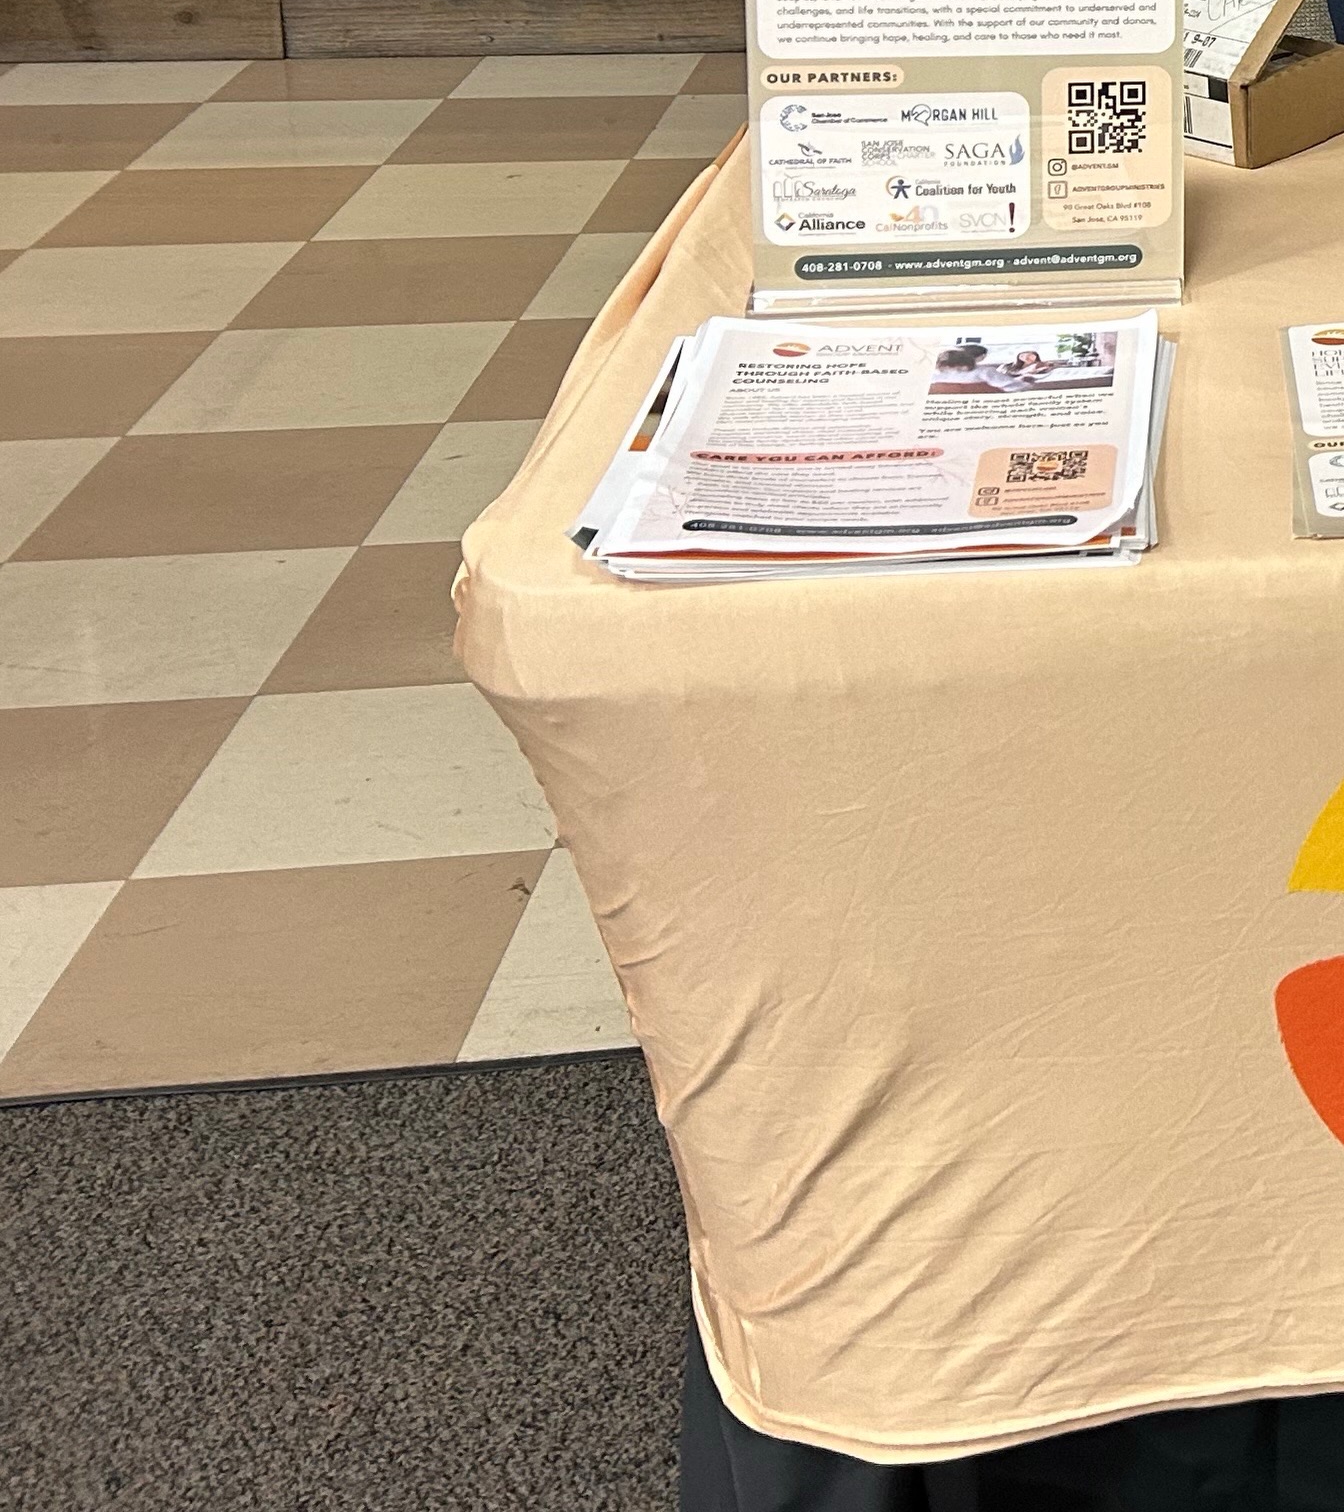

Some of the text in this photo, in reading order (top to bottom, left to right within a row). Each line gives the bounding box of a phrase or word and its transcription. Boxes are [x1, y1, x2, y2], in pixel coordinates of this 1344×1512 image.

[766, 71, 898, 84] OUR PARTNERS:
[972, 108, 998, 120] HILL
[945, 143, 1006, 159] SAGA
[915, 183, 1016, 196] Coalition for Youth
[799, 219, 866, 230] Alliance
[876, 221, 948, 232] CalNonprofits
[802, 252, 1137, 273] 408-281-0708 www.adventgm.org advent@adventgm.org
[818, 344, 902, 353] ADVENT
[696, 453, 748, 461] CARE
